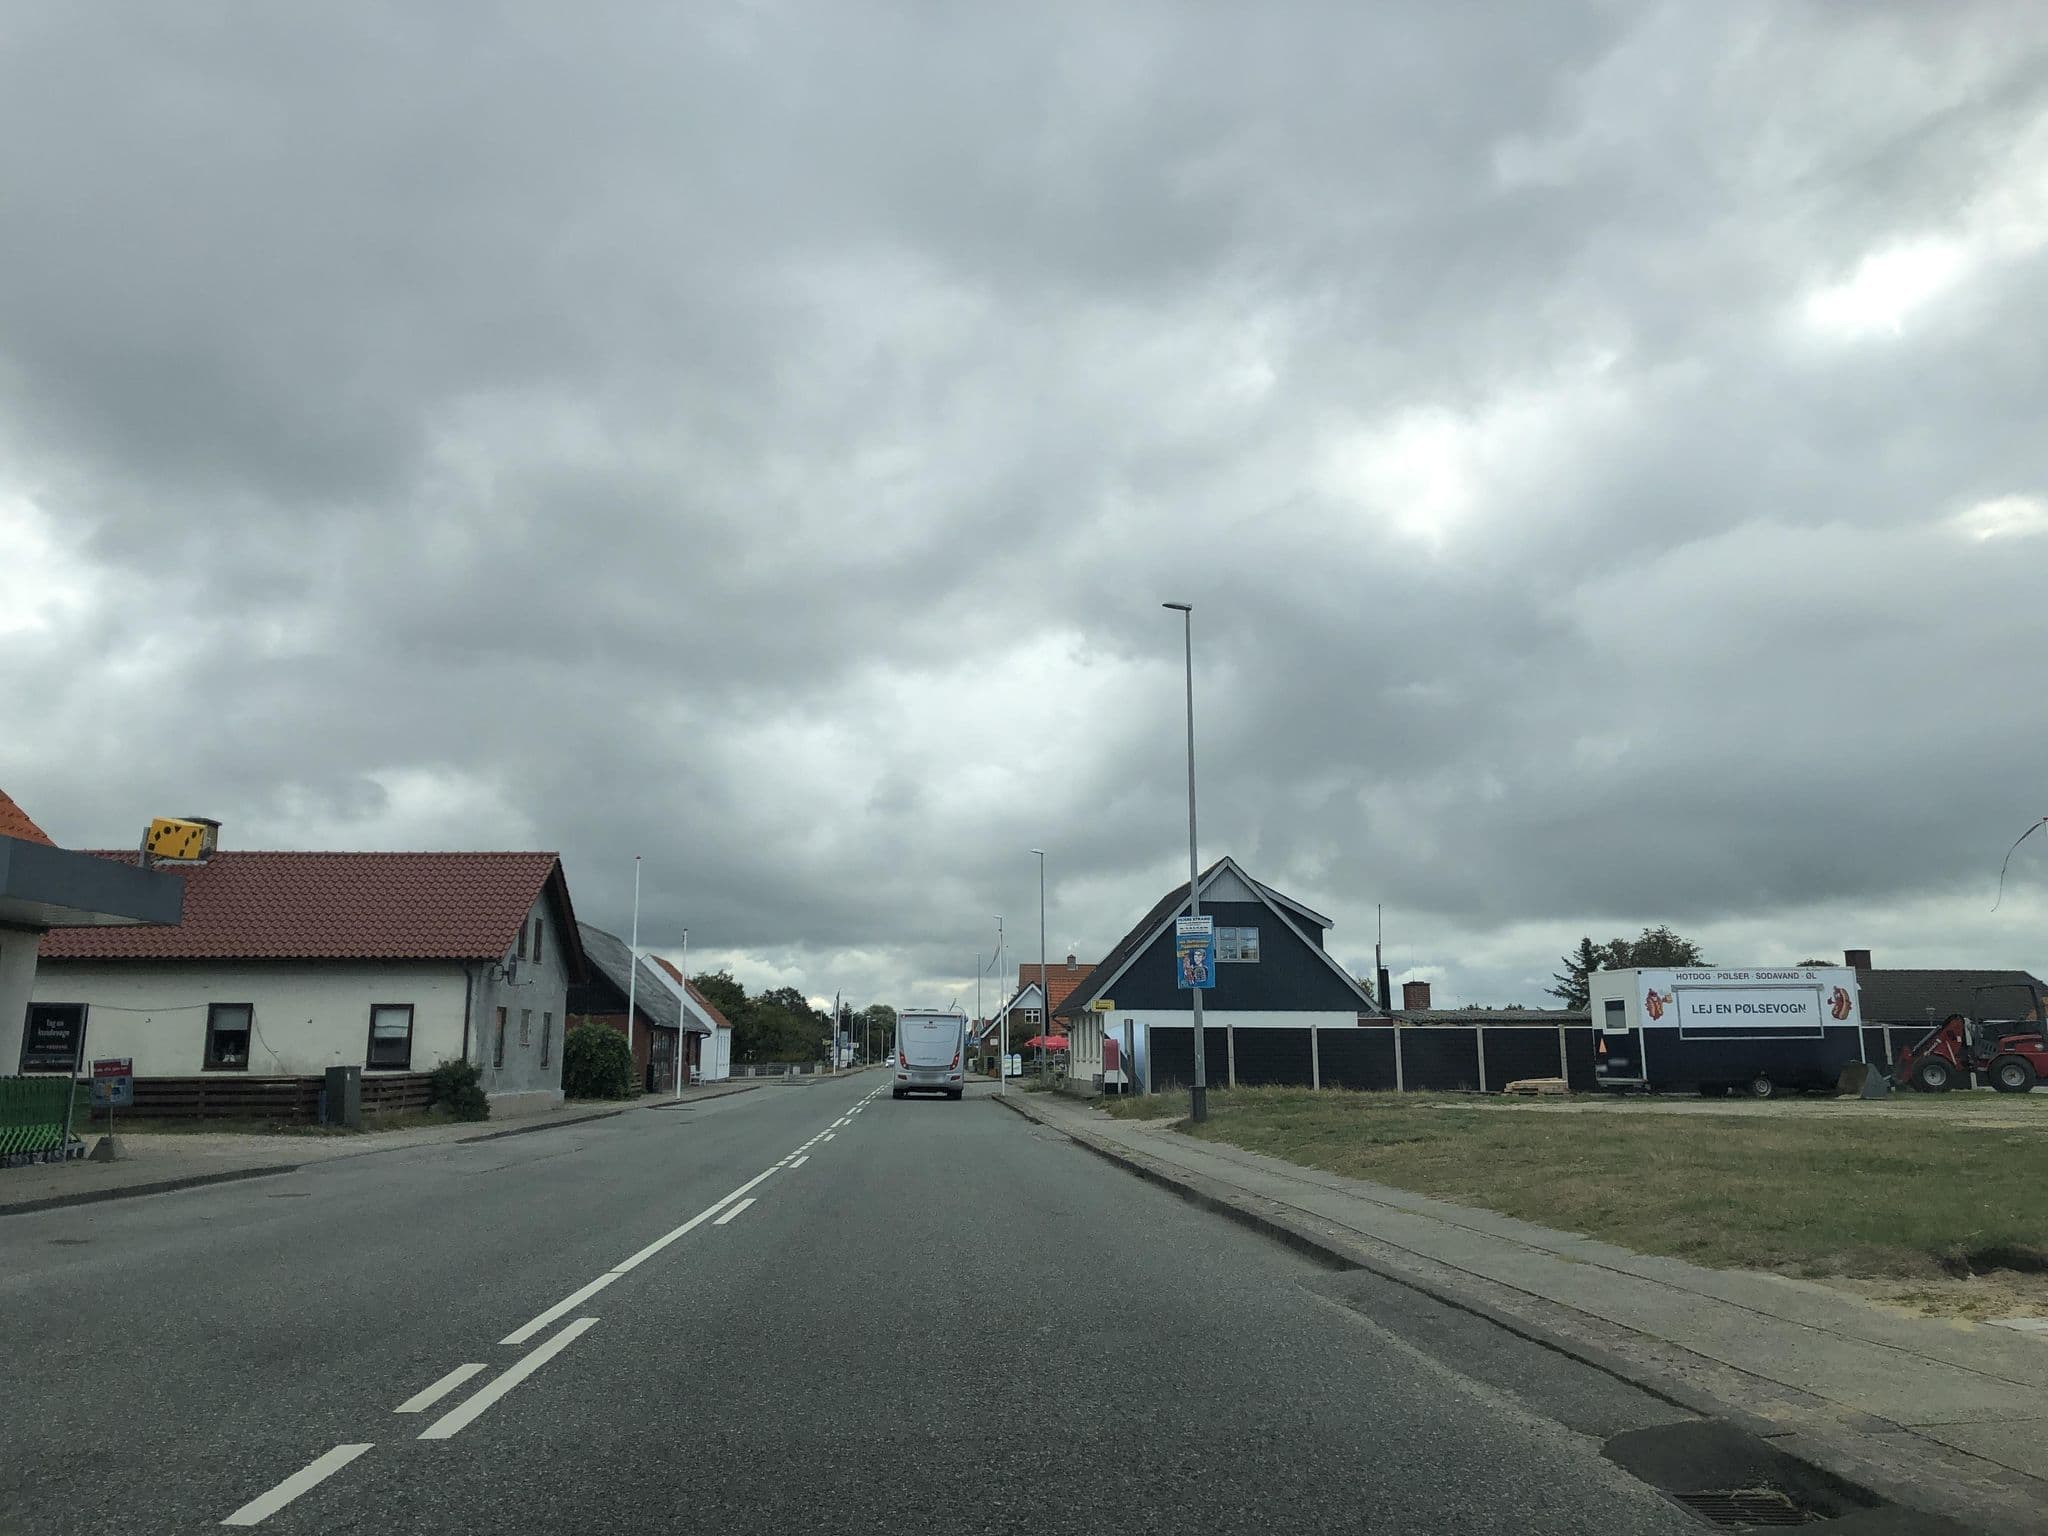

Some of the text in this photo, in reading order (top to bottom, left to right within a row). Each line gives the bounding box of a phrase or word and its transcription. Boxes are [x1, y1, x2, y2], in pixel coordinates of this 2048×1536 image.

[1676, 972, 1817, 980] HOTDOG PØLSER SODAVAND ØL
[1692, 1003, 1807, 1014] LEJ EN PØLSEVOGN
